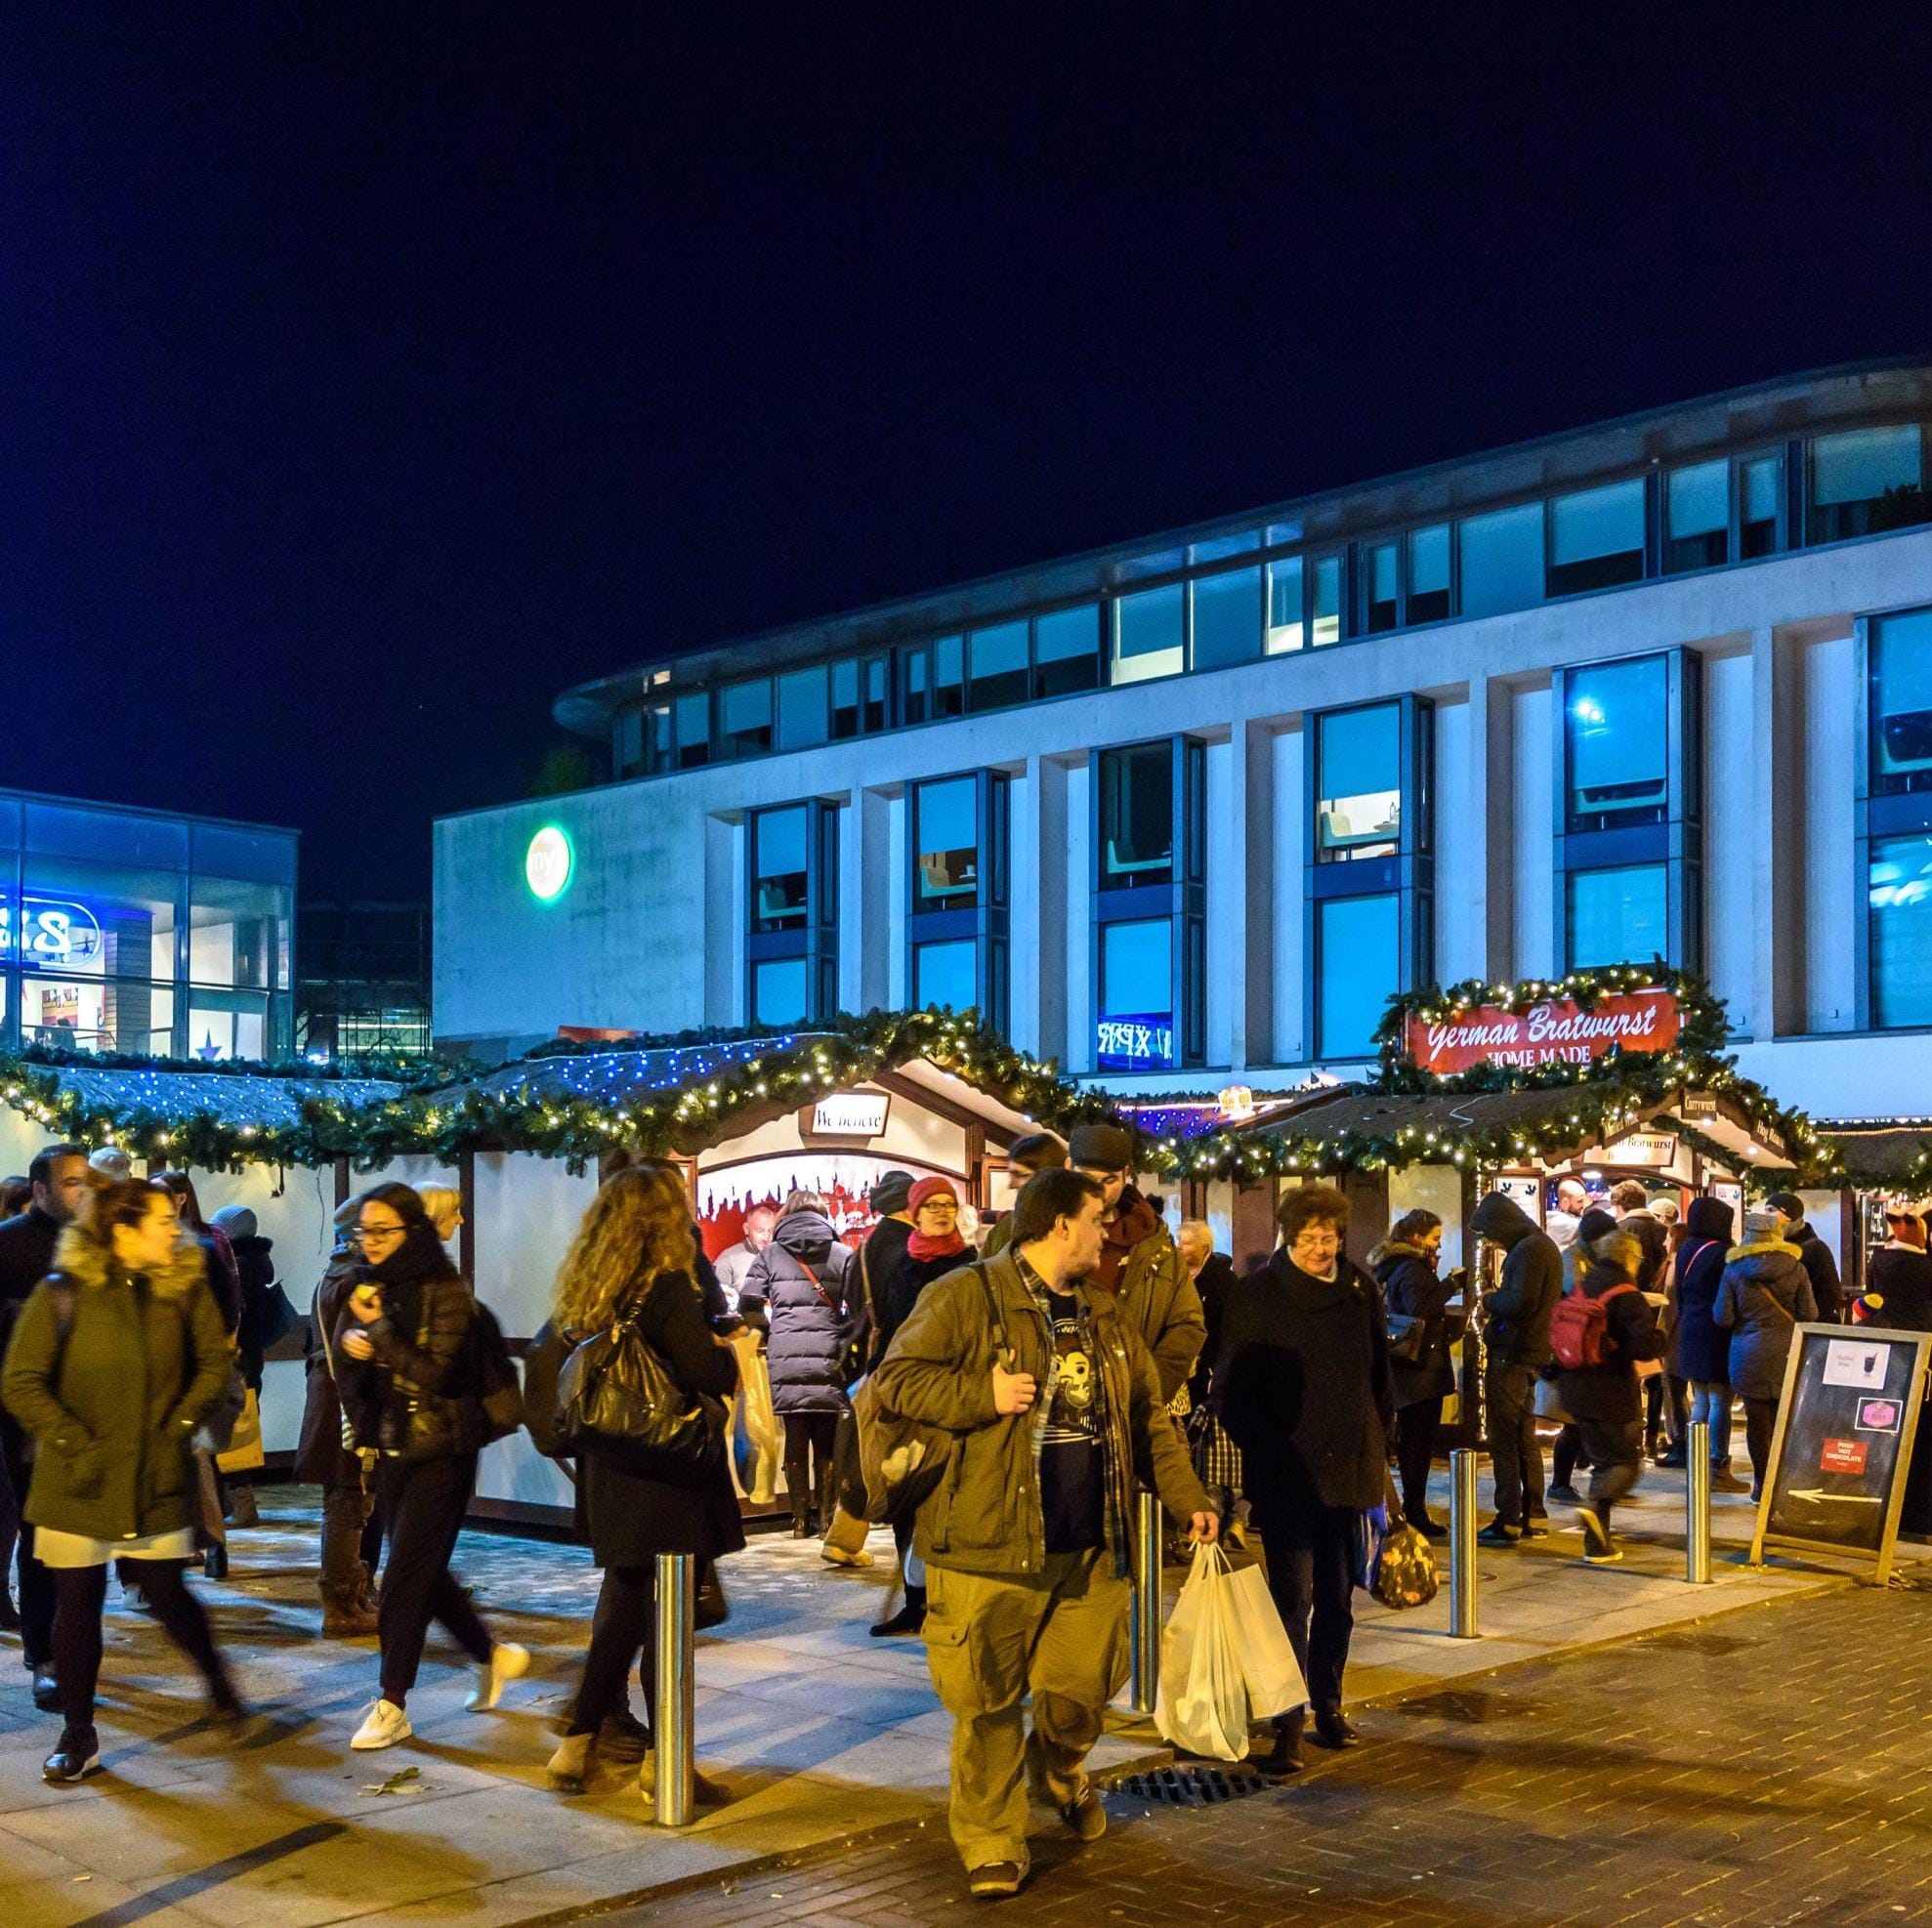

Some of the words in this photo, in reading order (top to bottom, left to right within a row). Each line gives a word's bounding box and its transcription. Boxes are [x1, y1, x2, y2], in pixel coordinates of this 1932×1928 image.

[1427, 1023, 1520, 1063] German
[1526, 1004, 1659, 1044] Bratwurst
[1487, 1048, 1535, 1069] HOME
[1538, 1045, 1592, 1066] MADE
[1685, 1095, 1716, 1115] Currywurst
[1756, 1120, 1769, 1143] Hog
[1826, 1453, 1862, 1462] CHOCOLATE
